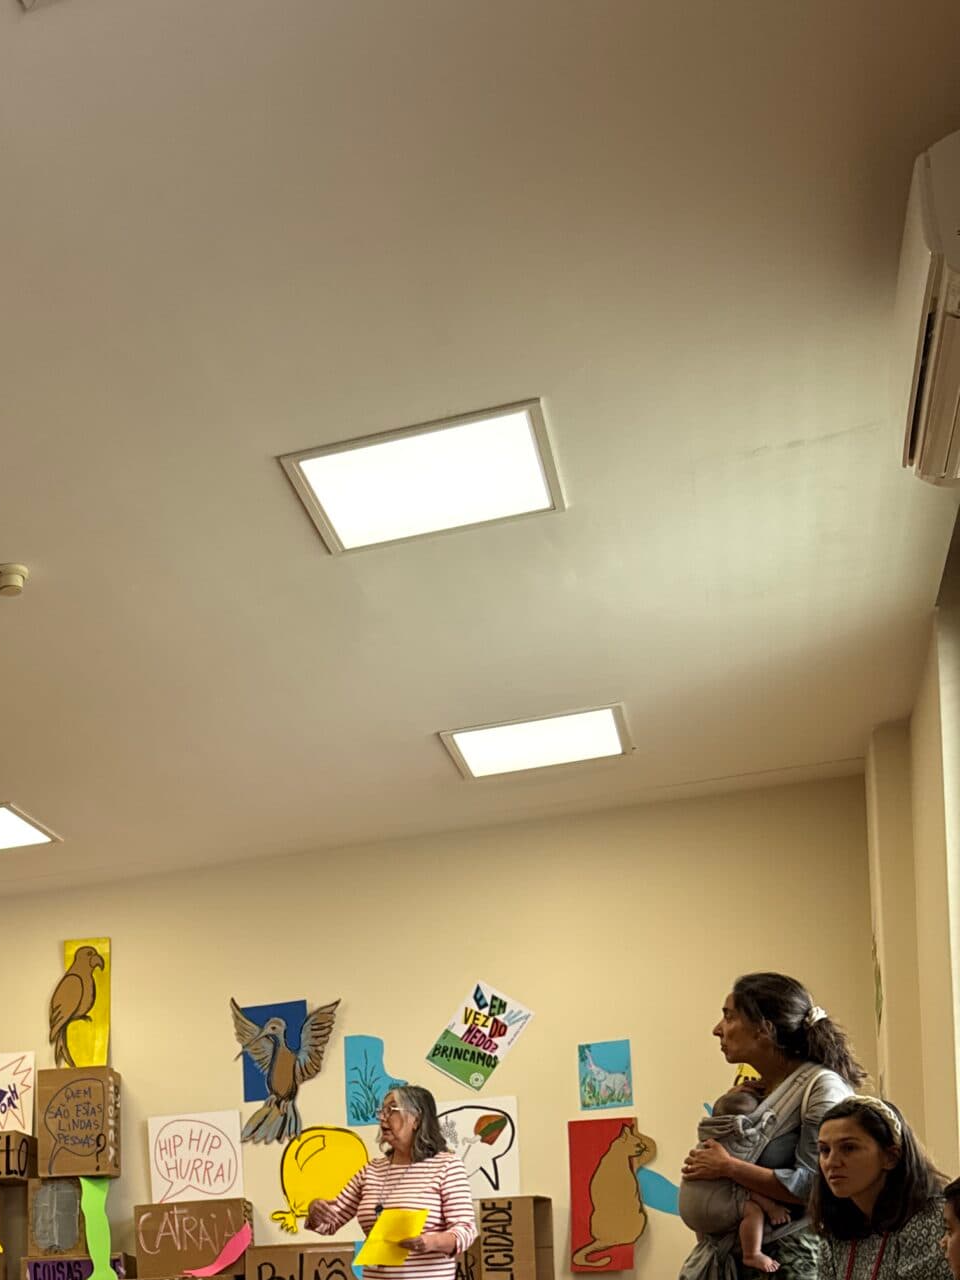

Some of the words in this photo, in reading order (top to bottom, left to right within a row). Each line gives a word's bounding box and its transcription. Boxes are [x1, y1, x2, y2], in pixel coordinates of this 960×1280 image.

[488, 994, 507, 1017] EM
[463, 1007, 490, 1028] VEZ
[488, 1017, 508, 1039] DO
[460, 1024, 499, 1054] MEDO?
[431, 1043, 499, 1069] BRINCAMOS
[64, 1087, 92, 1102] QUEM
[48, 1103, 70, 1119] SÃO
[75, 1101, 102, 1117] ESTAS
[159, 1135, 183, 1160] HIP
[189, 1128, 222, 1156] HIP
